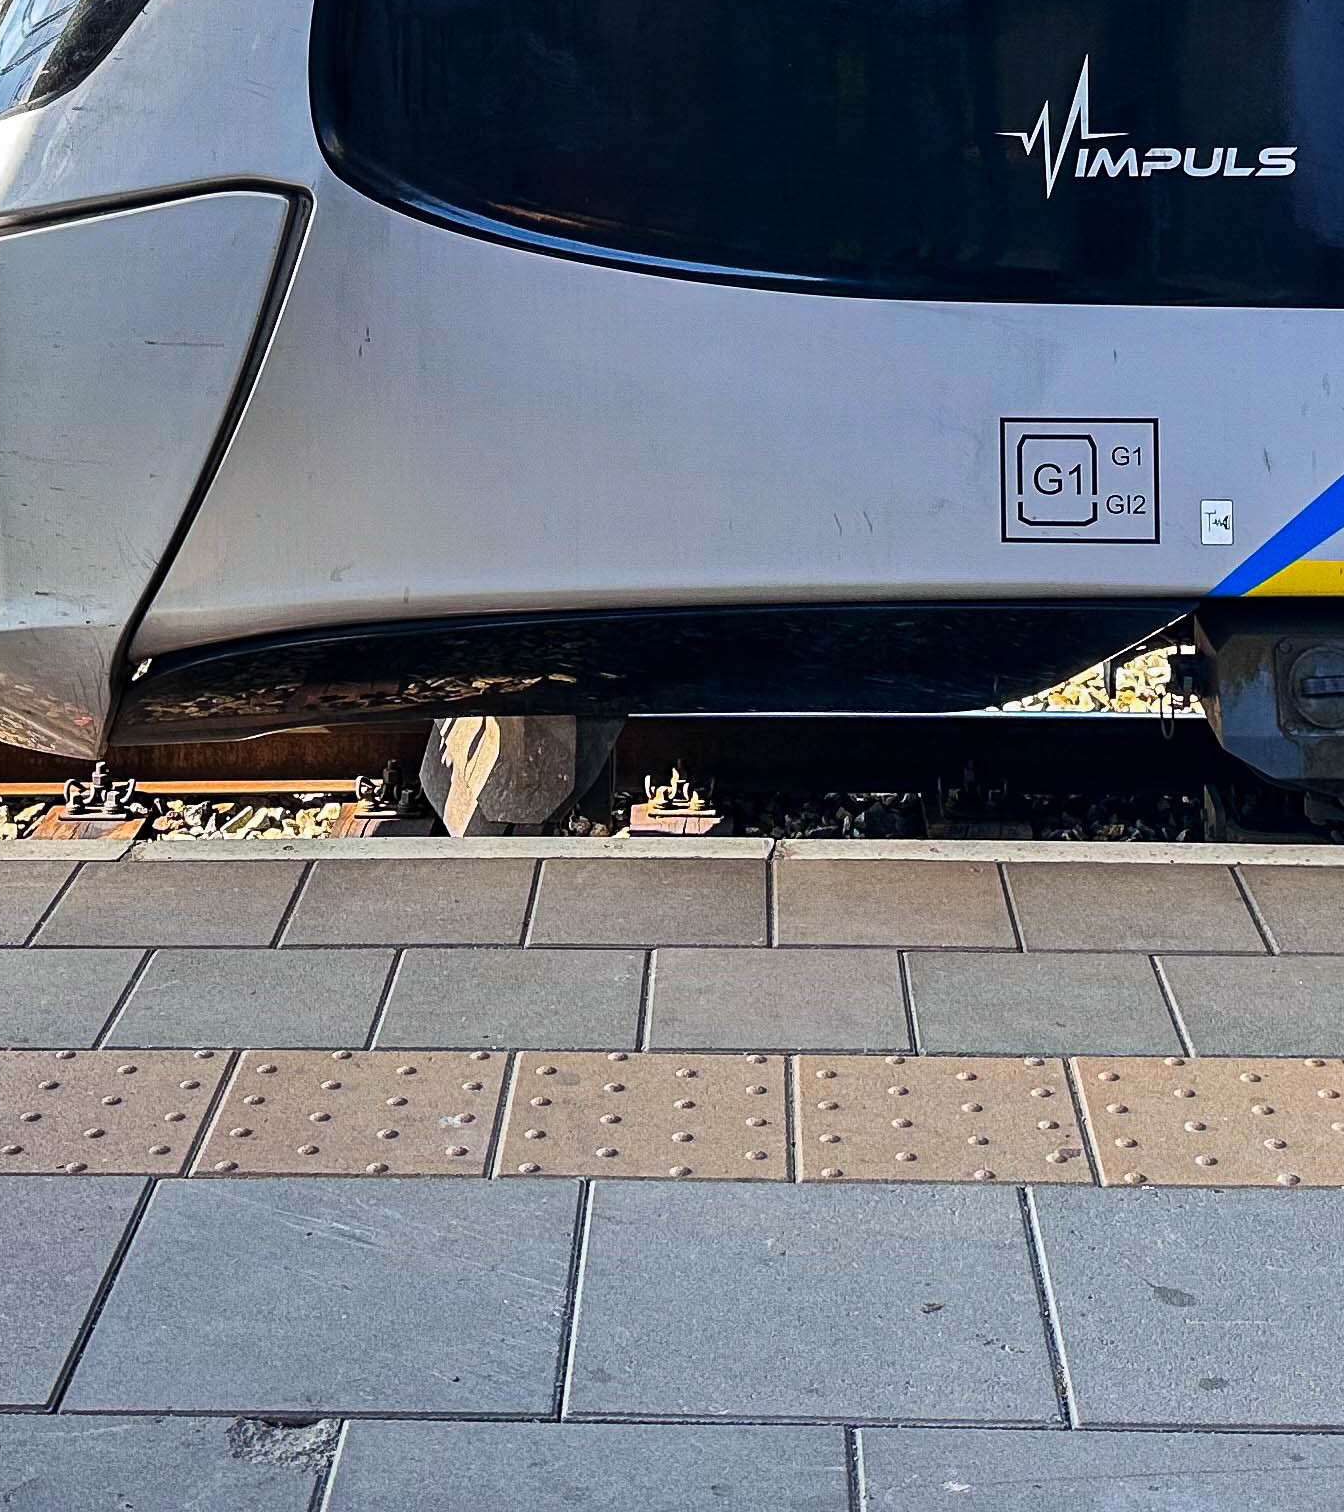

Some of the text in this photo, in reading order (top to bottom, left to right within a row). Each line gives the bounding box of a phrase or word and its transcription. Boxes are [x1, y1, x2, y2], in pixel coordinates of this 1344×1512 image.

[1073, 146, 1298, 178] IMPULS
[1110, 445, 1142, 467] G1
[1032, 462, 1083, 496] G1
